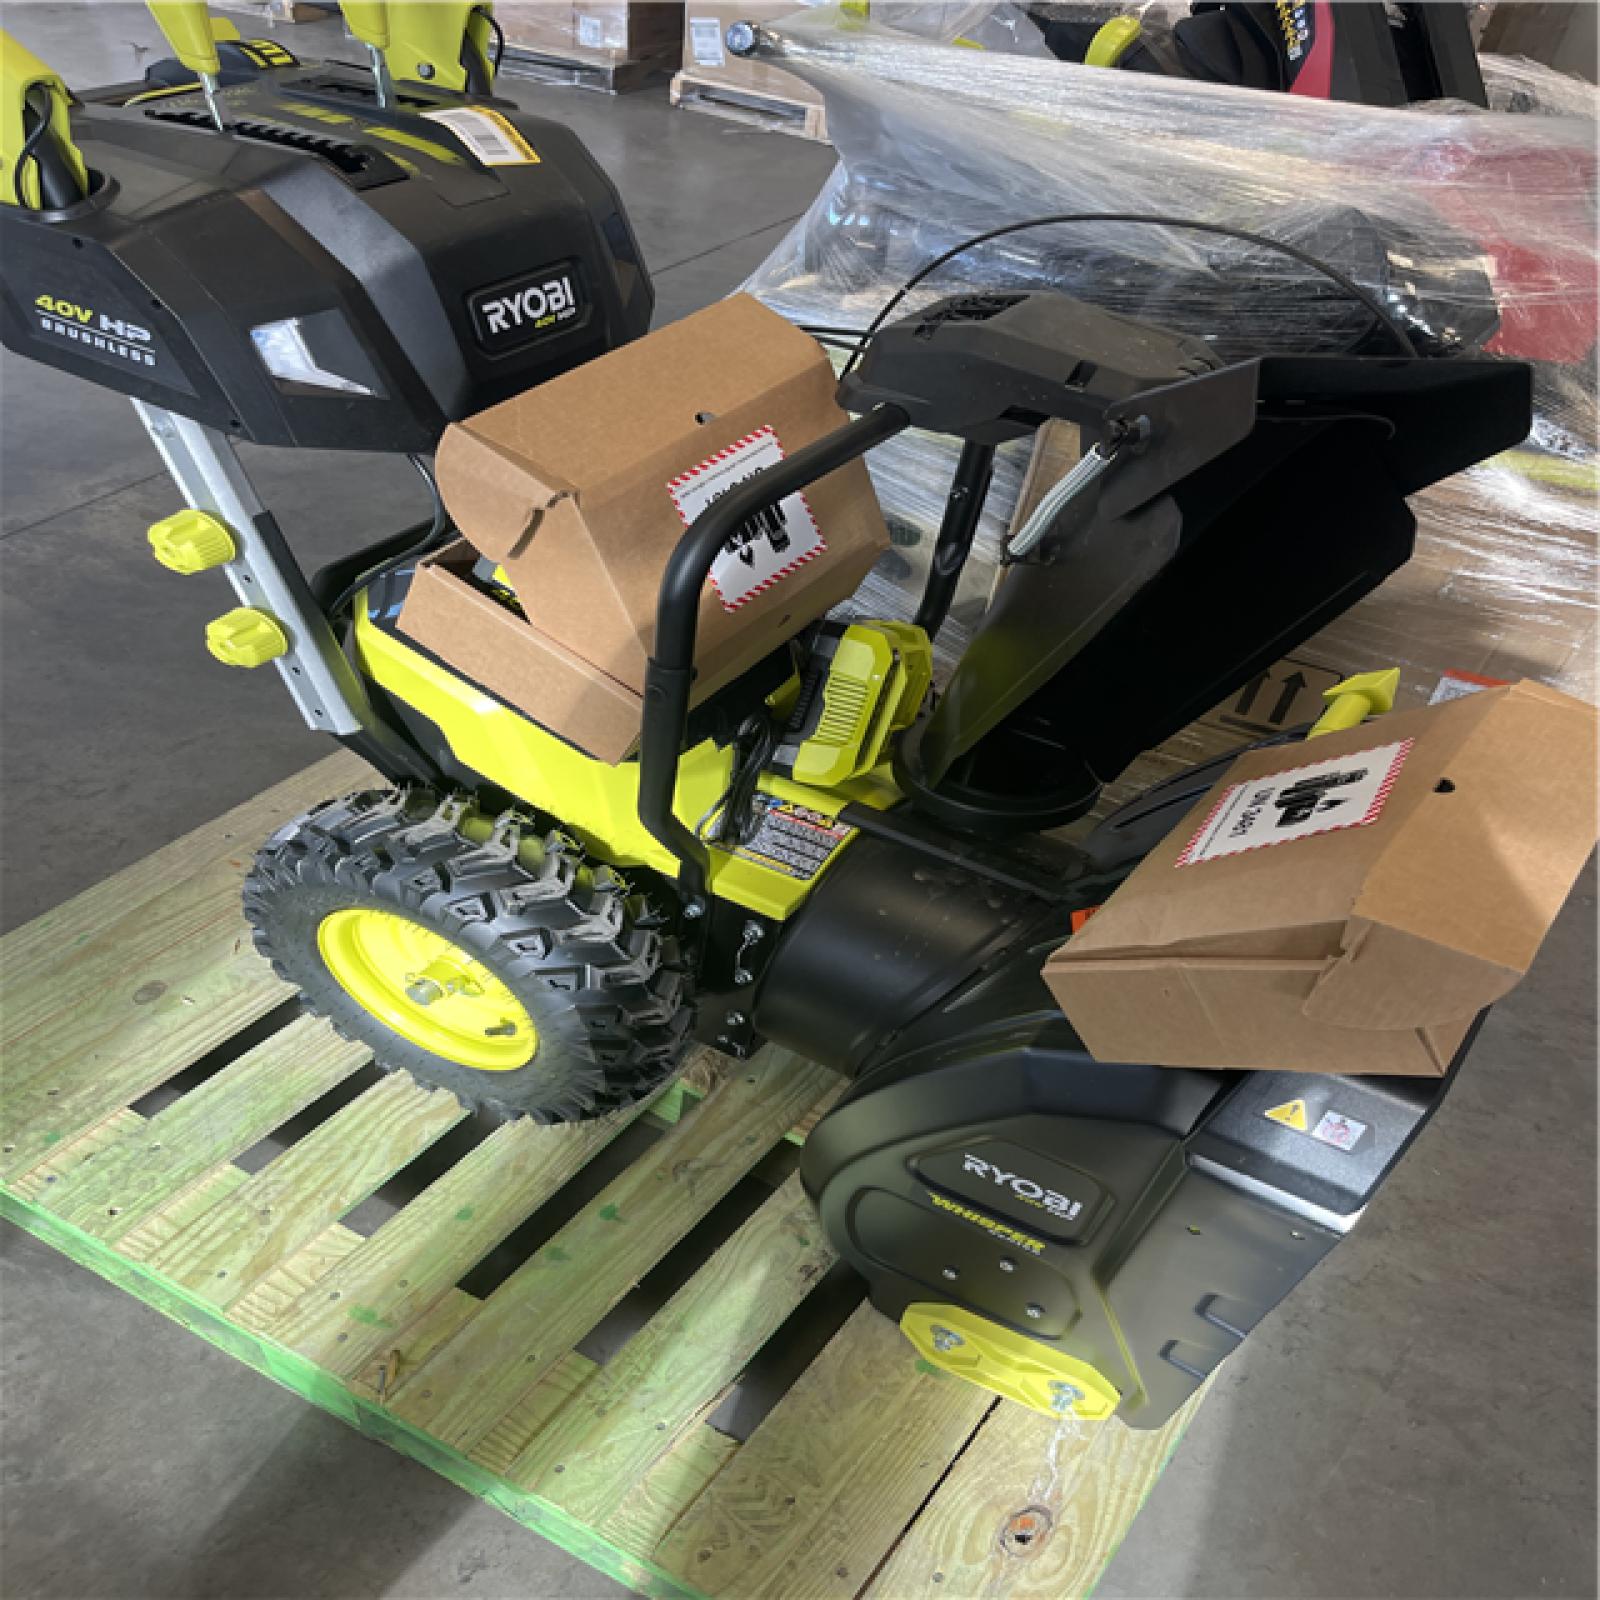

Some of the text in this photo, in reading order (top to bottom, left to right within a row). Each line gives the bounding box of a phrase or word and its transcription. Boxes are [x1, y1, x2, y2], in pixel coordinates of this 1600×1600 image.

[35, 294, 151, 341] 40V HP
[482, 276, 576, 334] RYOBI
[963, 1153, 1083, 1217] RYOBI
